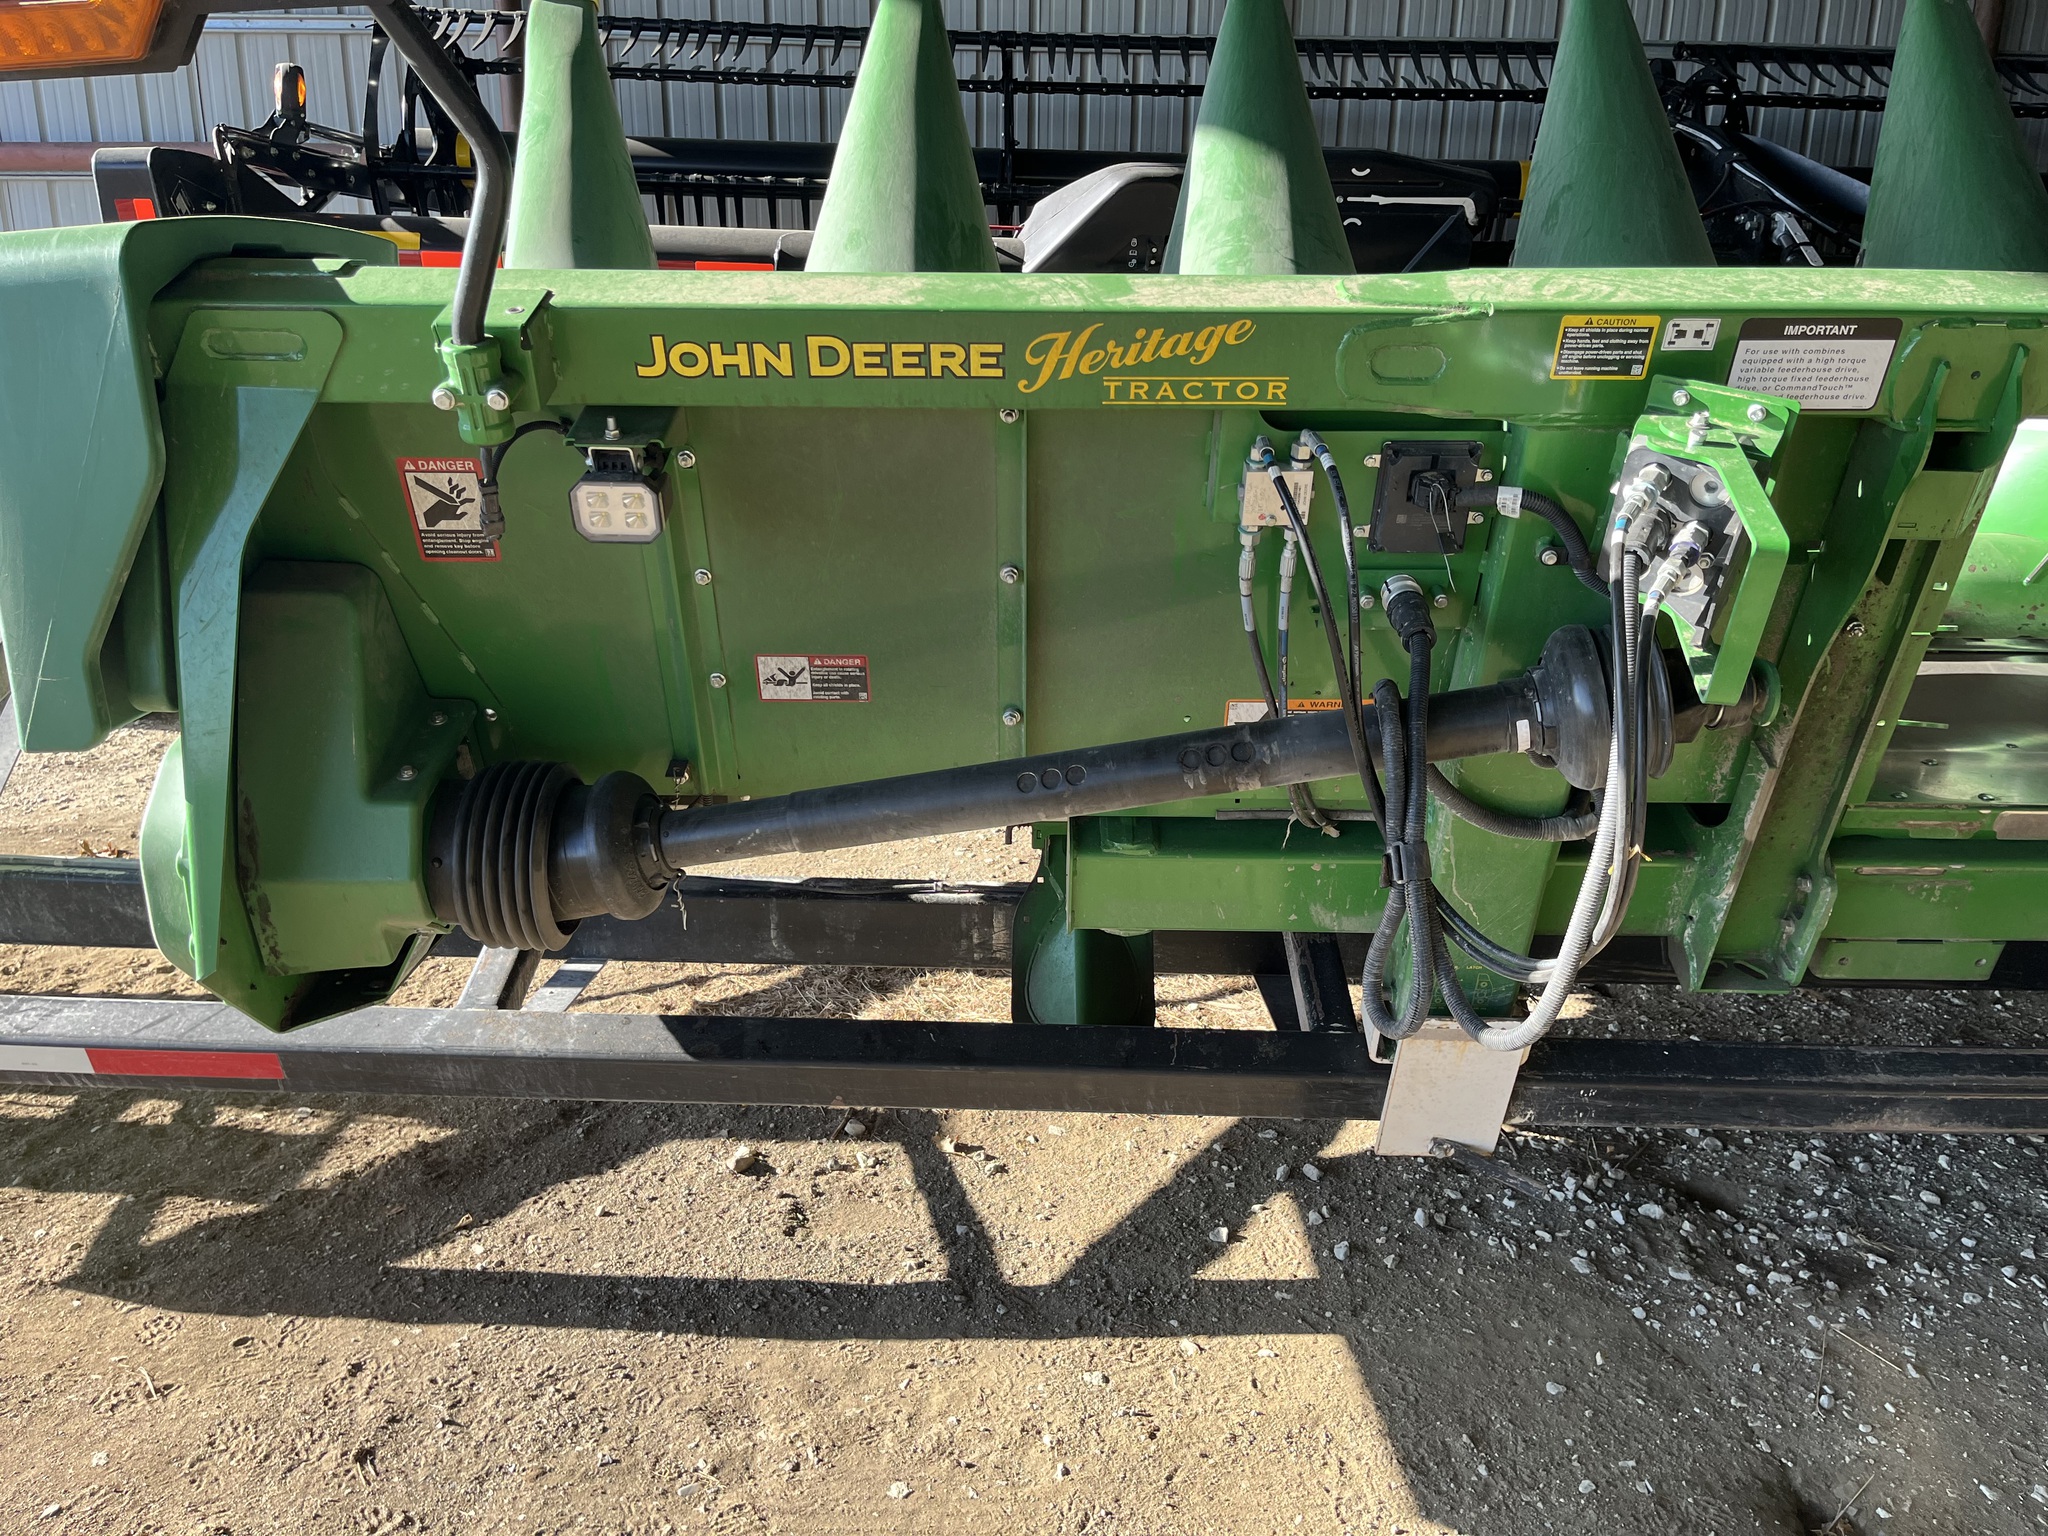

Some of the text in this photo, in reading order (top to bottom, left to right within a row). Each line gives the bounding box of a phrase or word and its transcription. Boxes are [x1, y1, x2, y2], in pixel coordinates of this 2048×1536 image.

[1784, 326, 1857, 335] IMPORTANT
[635, 334, 1005, 379] JOHN DEERE
[1018, 319, 1256, 393] Heritage
[1104, 381, 1287, 400] TRACTOR
[418, 461, 474, 470] DANGER
